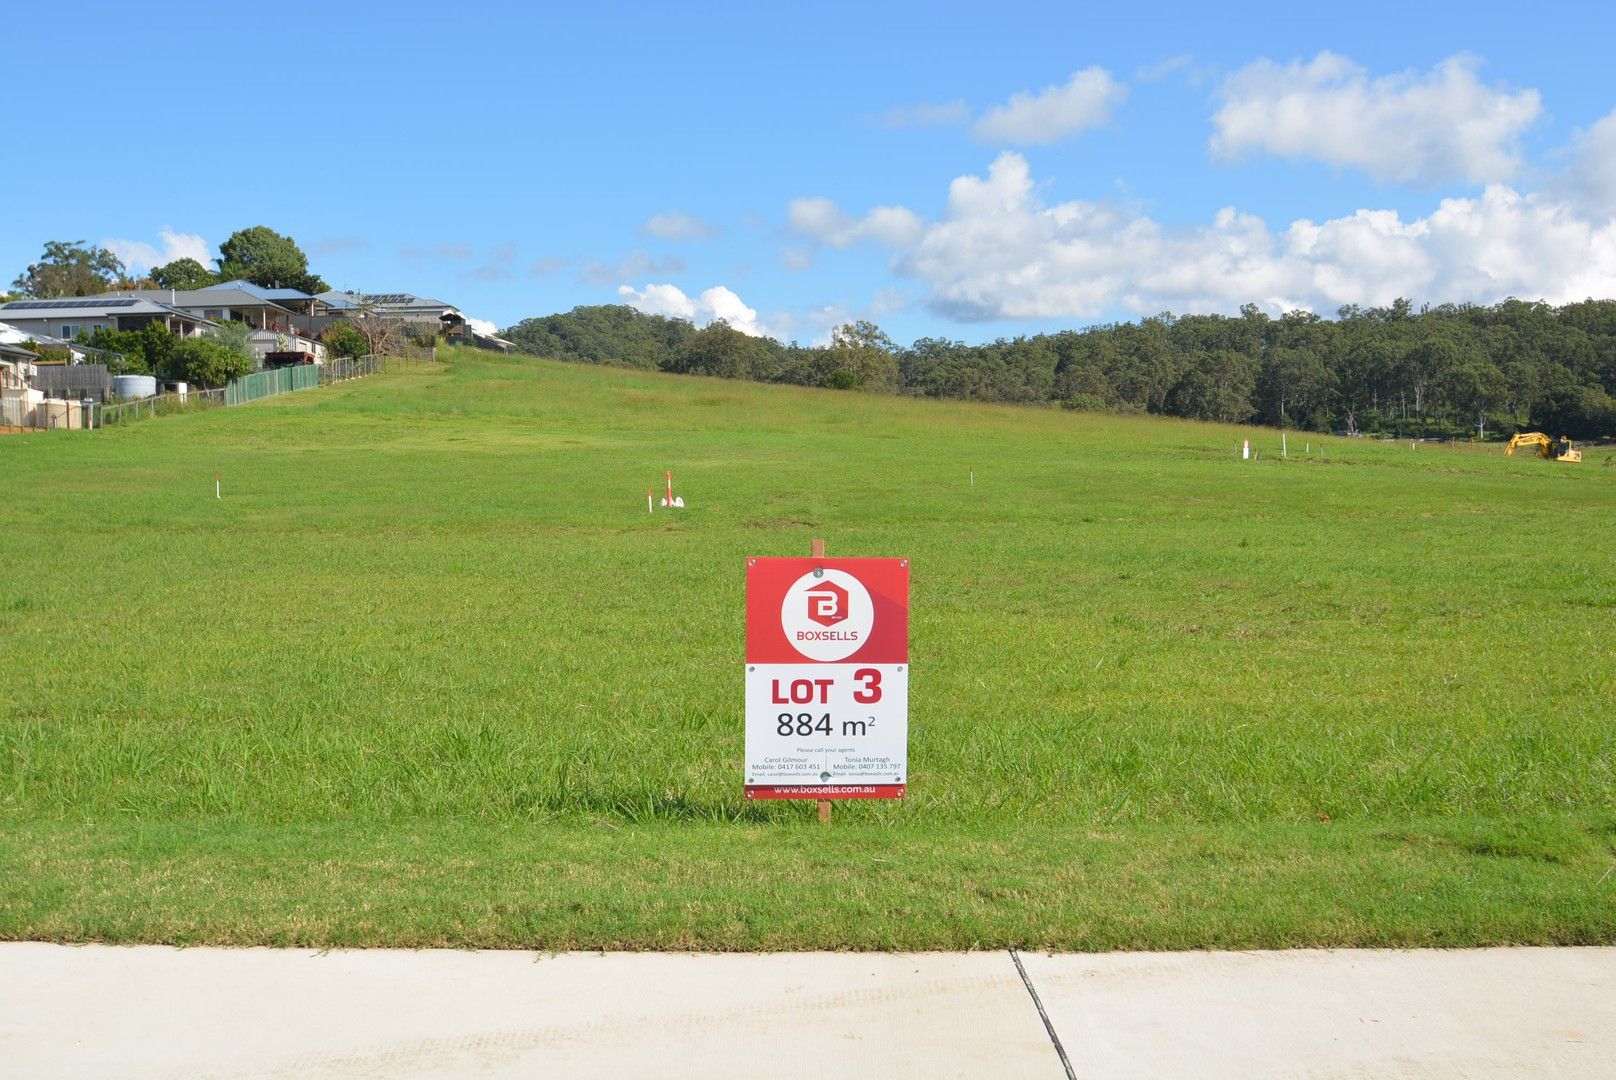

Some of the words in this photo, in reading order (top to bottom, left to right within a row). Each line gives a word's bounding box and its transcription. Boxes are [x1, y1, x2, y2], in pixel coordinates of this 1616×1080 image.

[797, 631, 858, 641] BOXSELLS
[772, 679, 834, 704] LOT
[853, 668, 882, 704] 3
[776, 713, 833, 737] 884
[773, 785, 876, 794] www.boxsells.com.au
